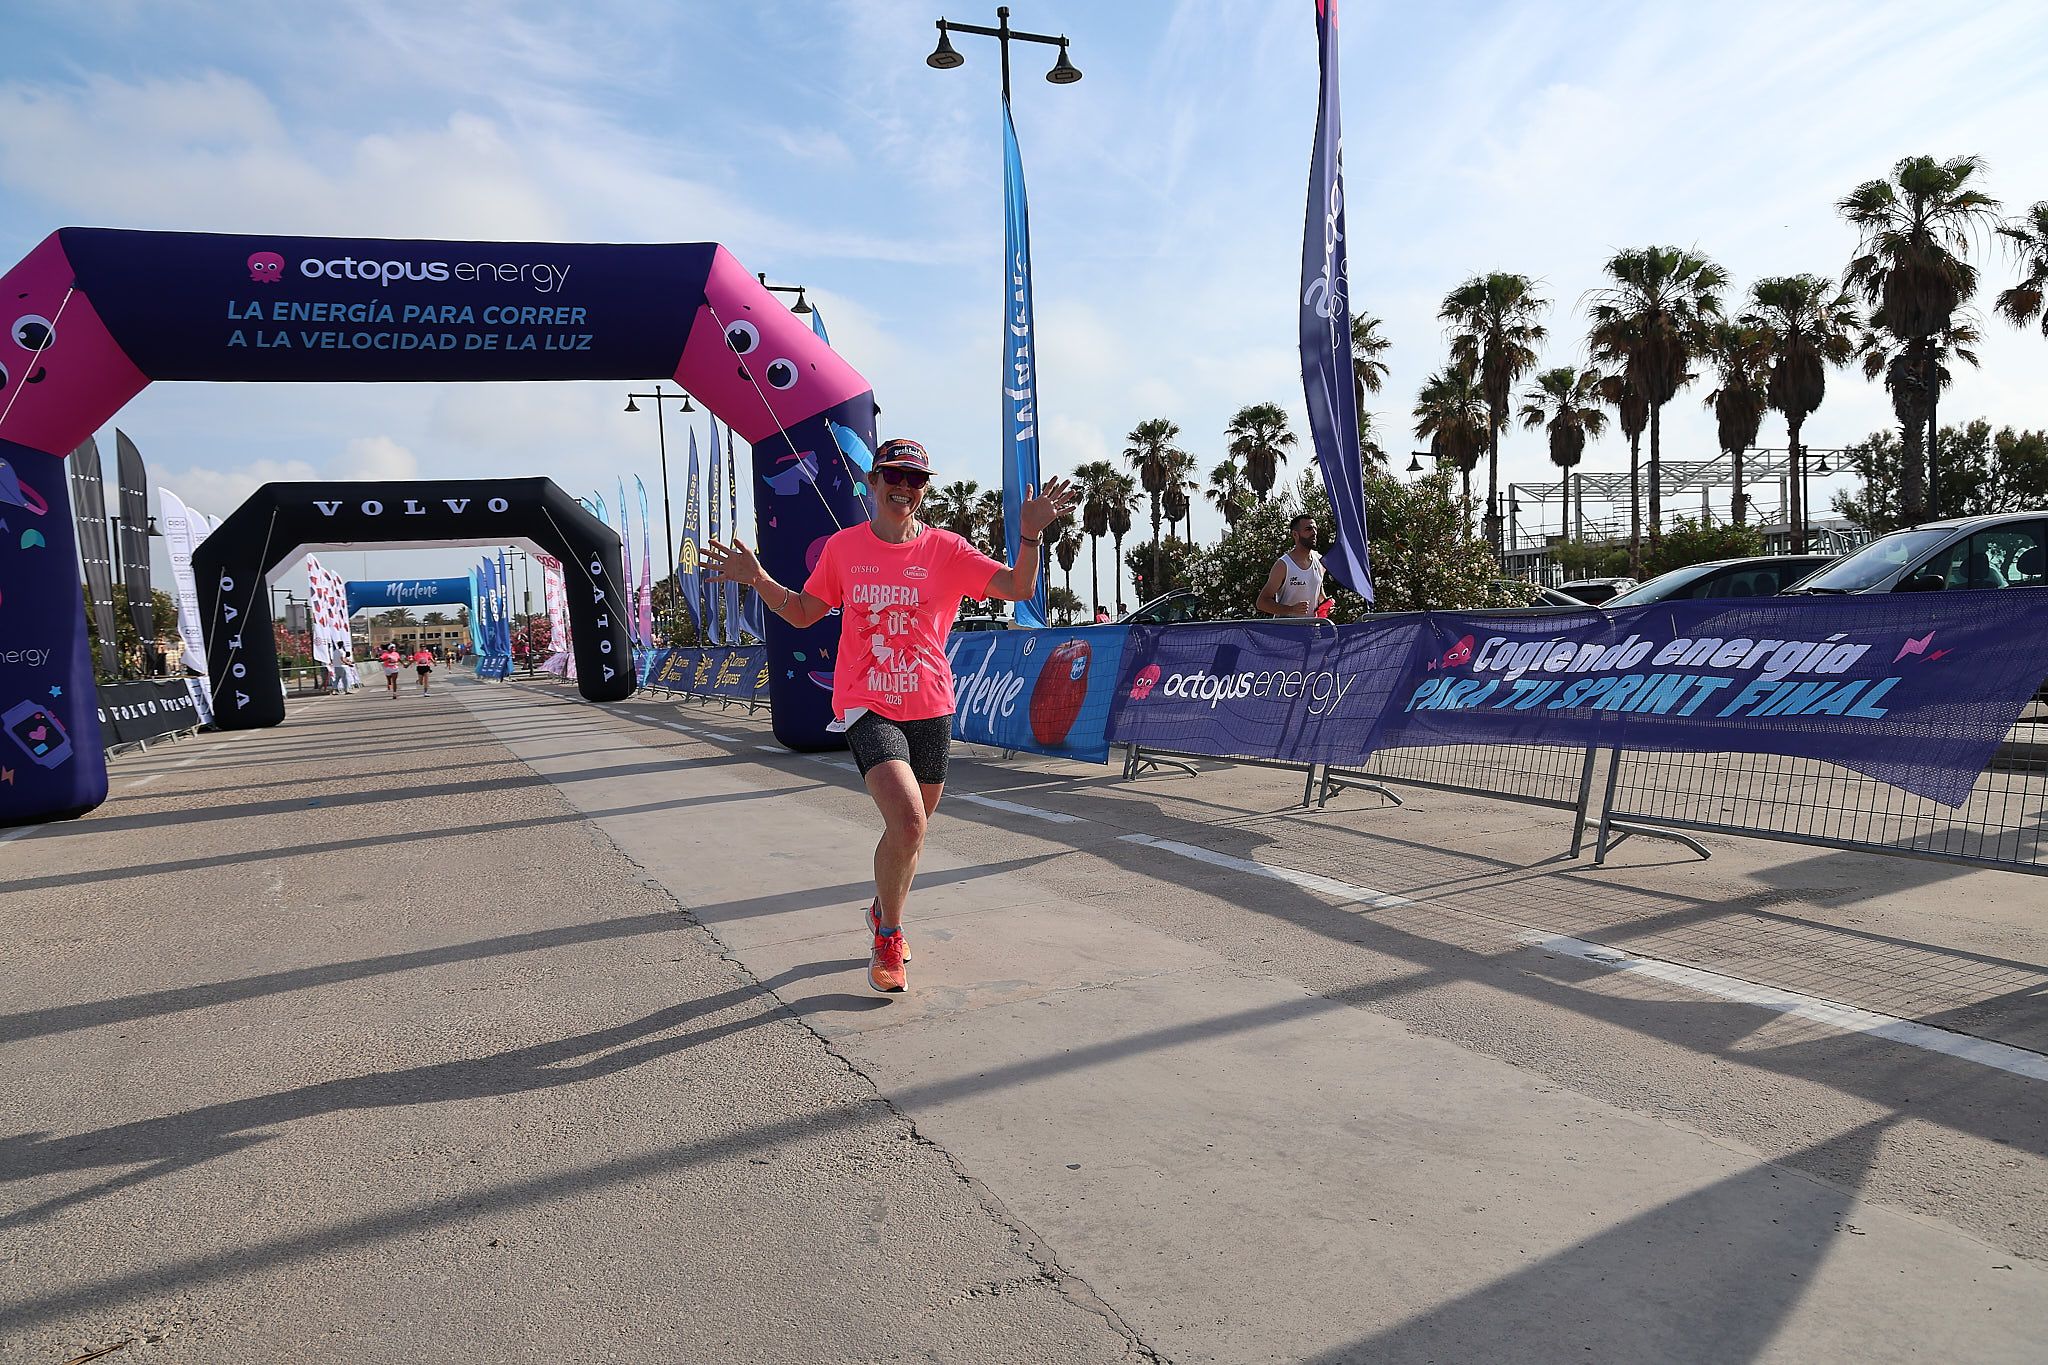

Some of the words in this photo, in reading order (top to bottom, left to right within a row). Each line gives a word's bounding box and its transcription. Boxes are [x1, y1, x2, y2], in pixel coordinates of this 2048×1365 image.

[299, 256, 450, 287] octopus
[454, 262, 571, 293] energy
[227, 300, 264, 320] LA
[272, 298, 394, 323] ENERGÍA
[402, 304, 476, 324] PARA
[483, 305, 587, 325] CORRER
[227, 330, 248, 347] A
[256, 331, 292, 348] LA
[300, 332, 457, 350] VELOCIDAD
[464, 334, 498, 350] DE
[505, 334, 538, 350] LA
[545, 334, 593, 350] LUZ
[312, 497, 509, 516] VOLVO
[850, 565, 879, 574] OYSHO
[386, 581, 438, 603] Marlene
[852, 584, 920, 607] CARRERA
[590, 560, 615, 682] VOLVO
[888, 611, 910, 635] DE
[219, 576, 250, 710] VOLVO
[0, 648, 50, 667] ergy
[889, 649, 908, 673] LA
[1651, 633, 1872, 682] energía
[868, 669, 919, 693] MUJER
[947, 636, 1025, 735] rlene
[1163, 670, 1254, 709] octopus
[1253, 670, 1357, 716] energy
[110, 701, 157, 721] VOLVO
[160, 694, 193, 711] VOLVO
[1404, 676, 1500, 712] PARA
[1491, 679, 1565, 710] TU
[1547, 674, 1735, 717] SPRINT
[1715, 677, 1902, 719] FINAL
